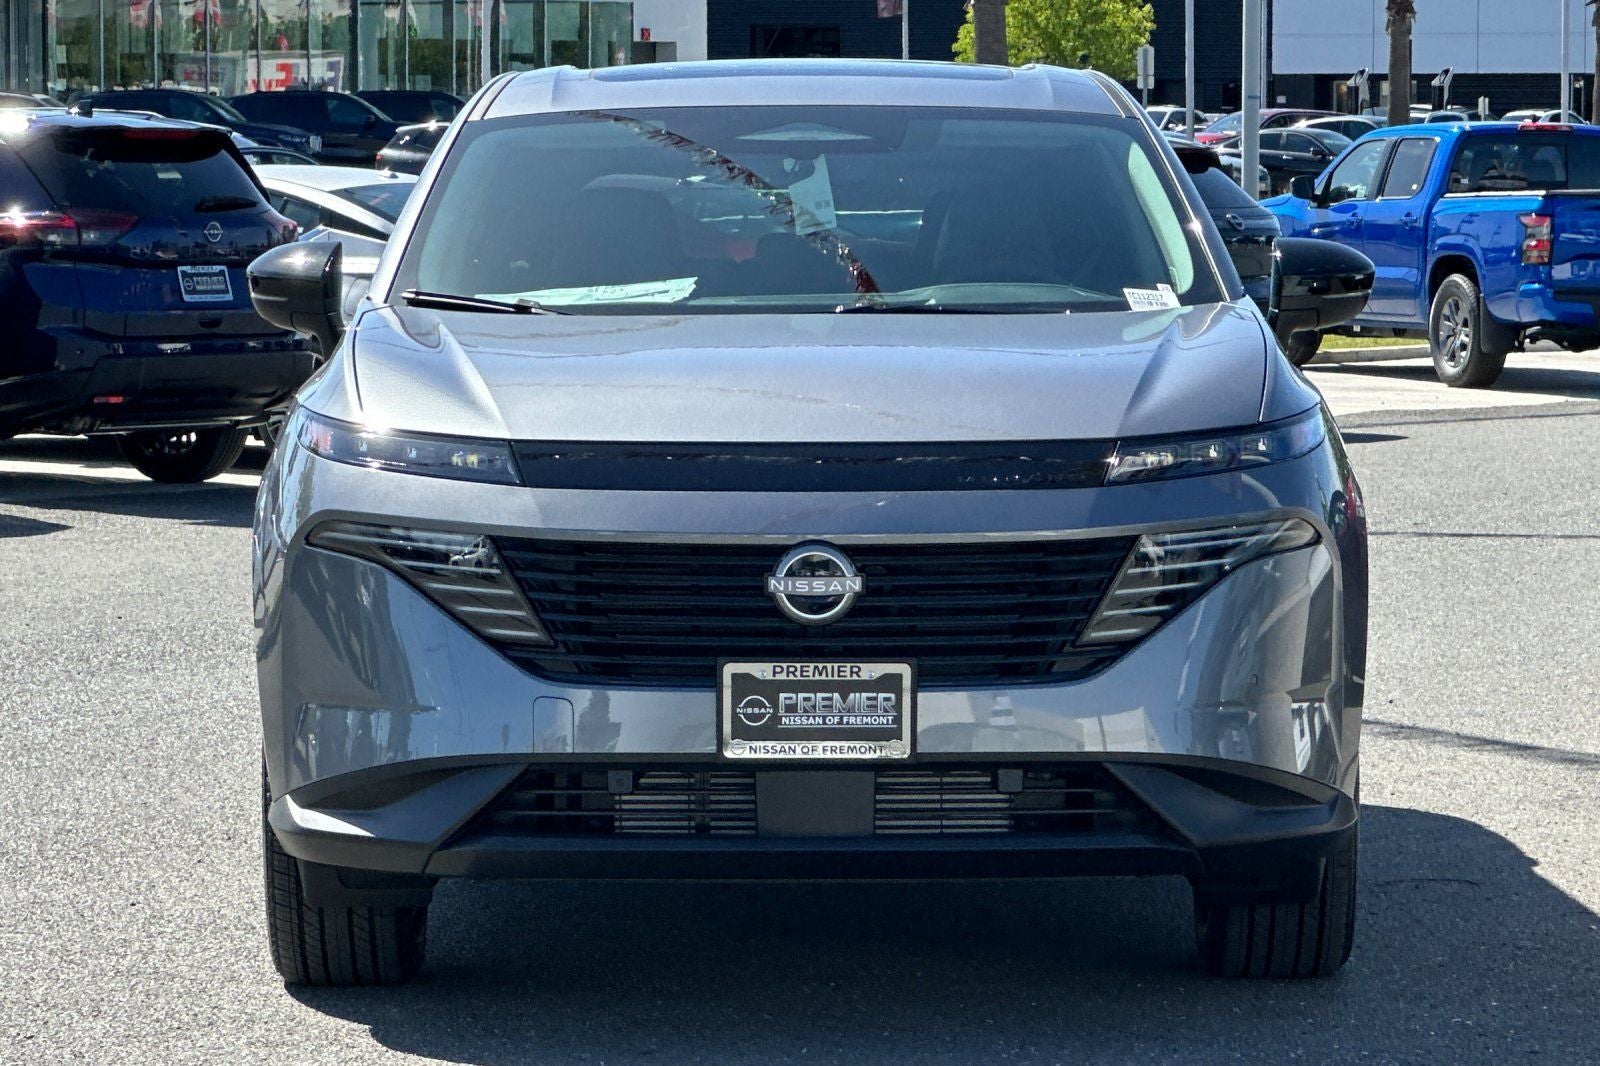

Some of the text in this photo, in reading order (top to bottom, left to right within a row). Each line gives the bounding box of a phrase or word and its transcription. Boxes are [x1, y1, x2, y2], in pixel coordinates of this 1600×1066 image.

[770, 579, 861, 592] NISSAN
[772, 665, 862, 678] PREMIER
[778, 692, 897, 713] PREMIER
[781, 716, 894, 725] NISSAN OF FREMONT
[748, 744, 885, 755] NISSAN OF FREMONT
